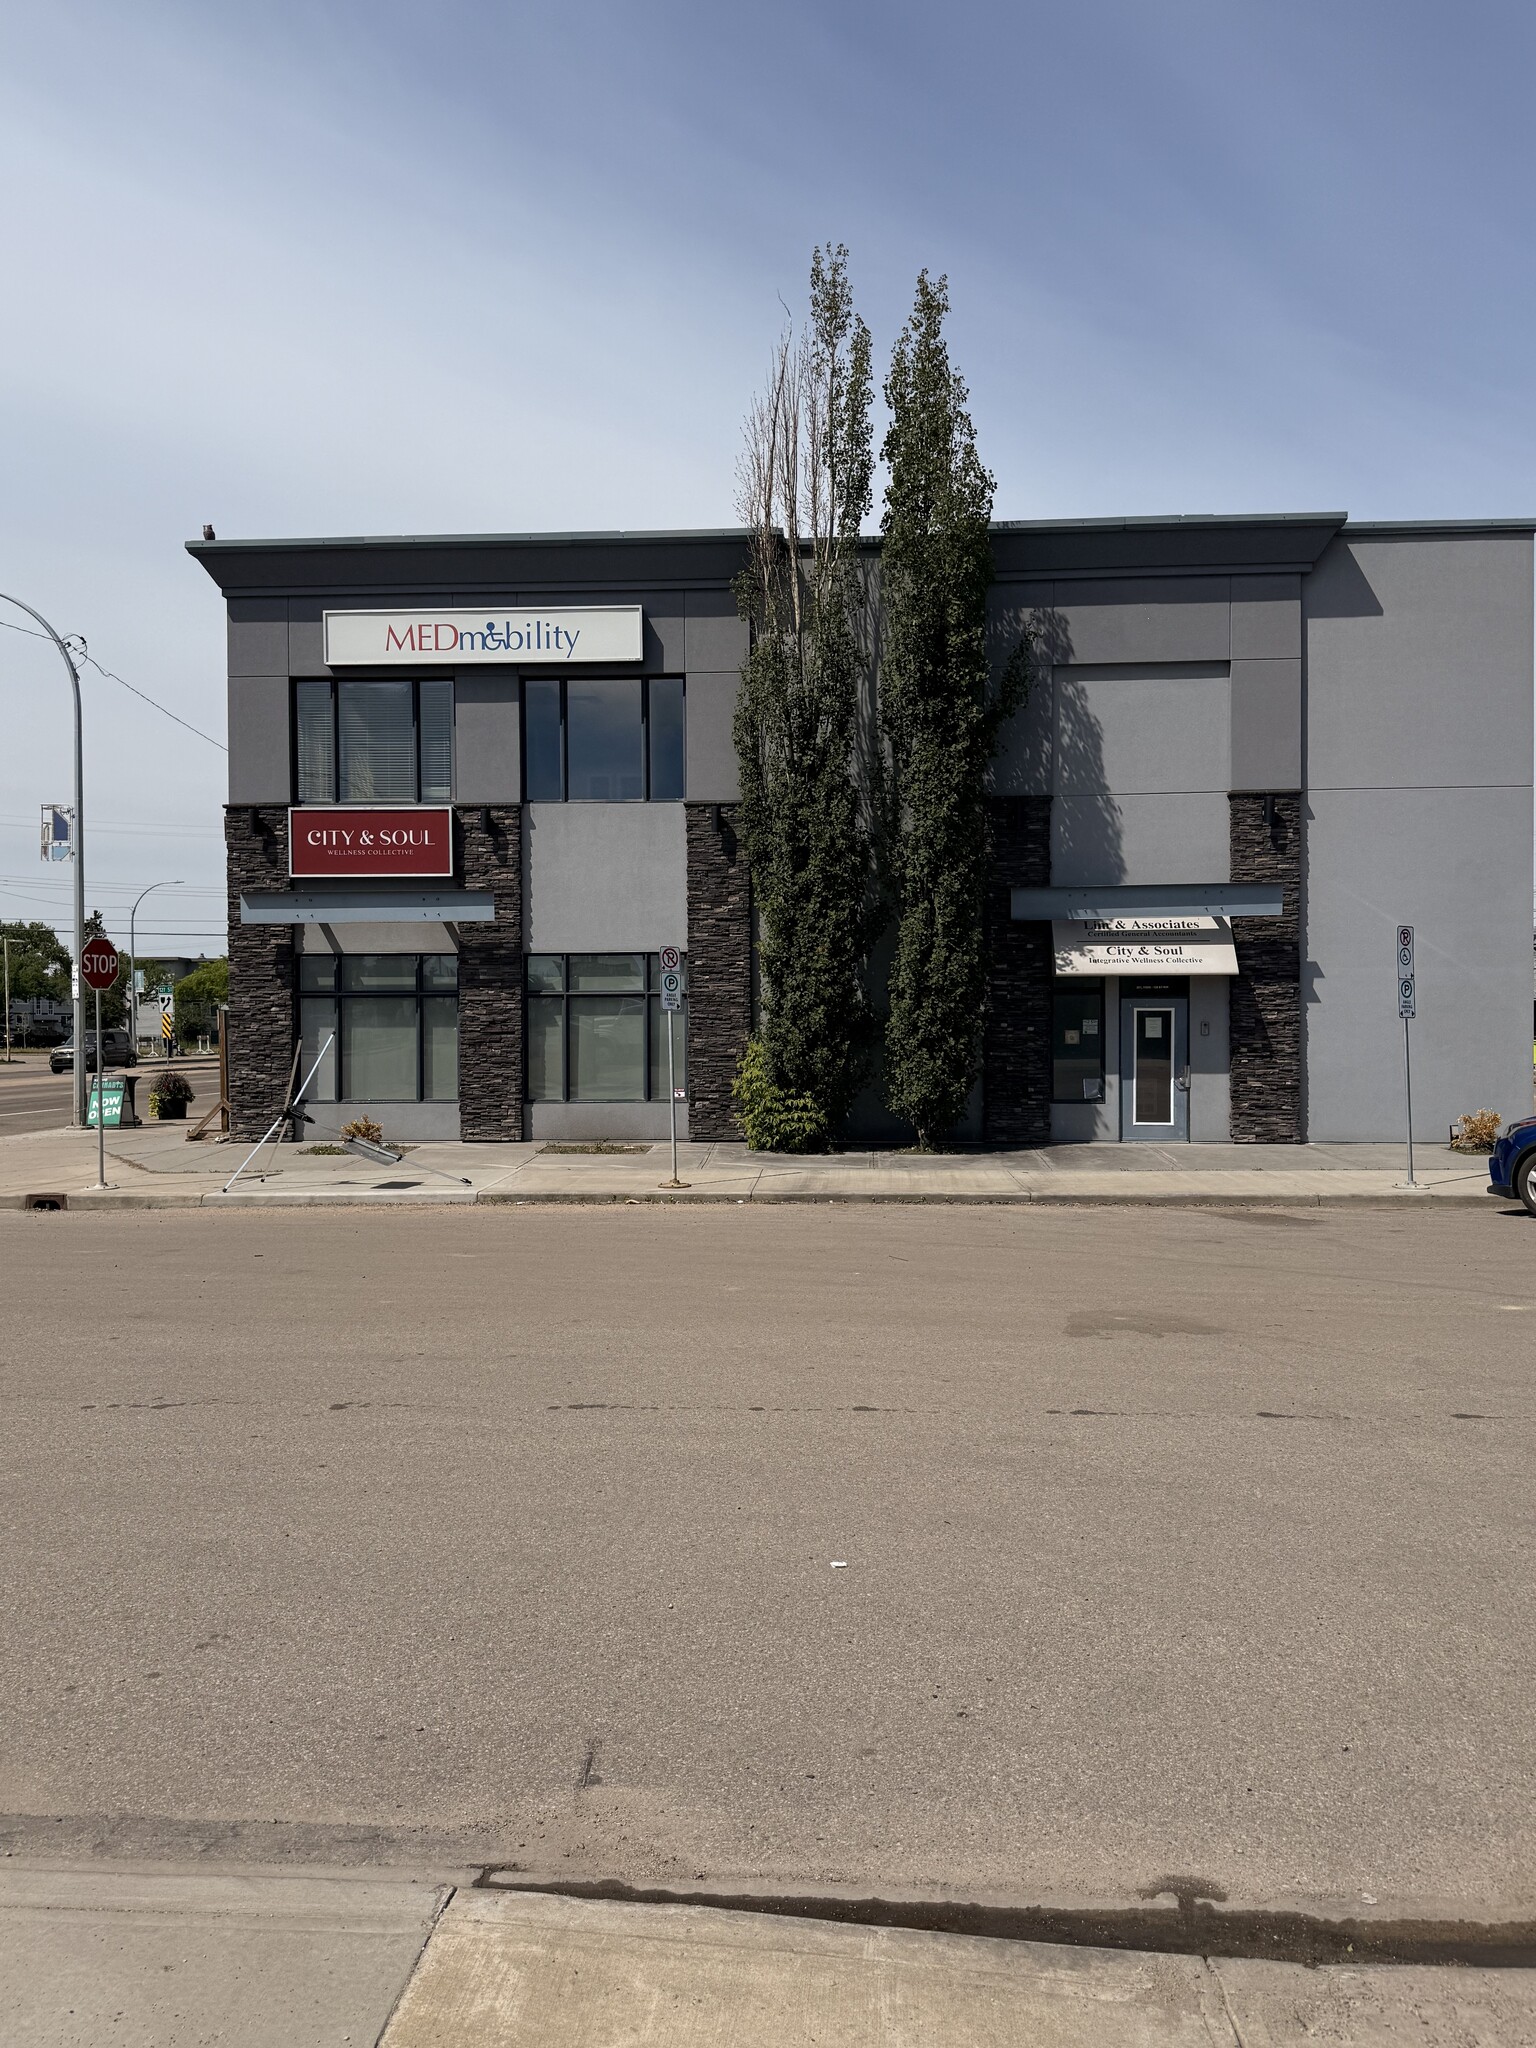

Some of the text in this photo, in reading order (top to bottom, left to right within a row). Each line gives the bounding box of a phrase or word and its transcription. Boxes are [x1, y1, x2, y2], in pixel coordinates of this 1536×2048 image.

[307, 829, 436, 846] CITY & SOUL
[1115, 920, 1126, 930] &
[1132, 920, 1200, 929] Associates
[1106, 945, 1183, 957] City & Soul
[83, 953, 117, 974] STOP
